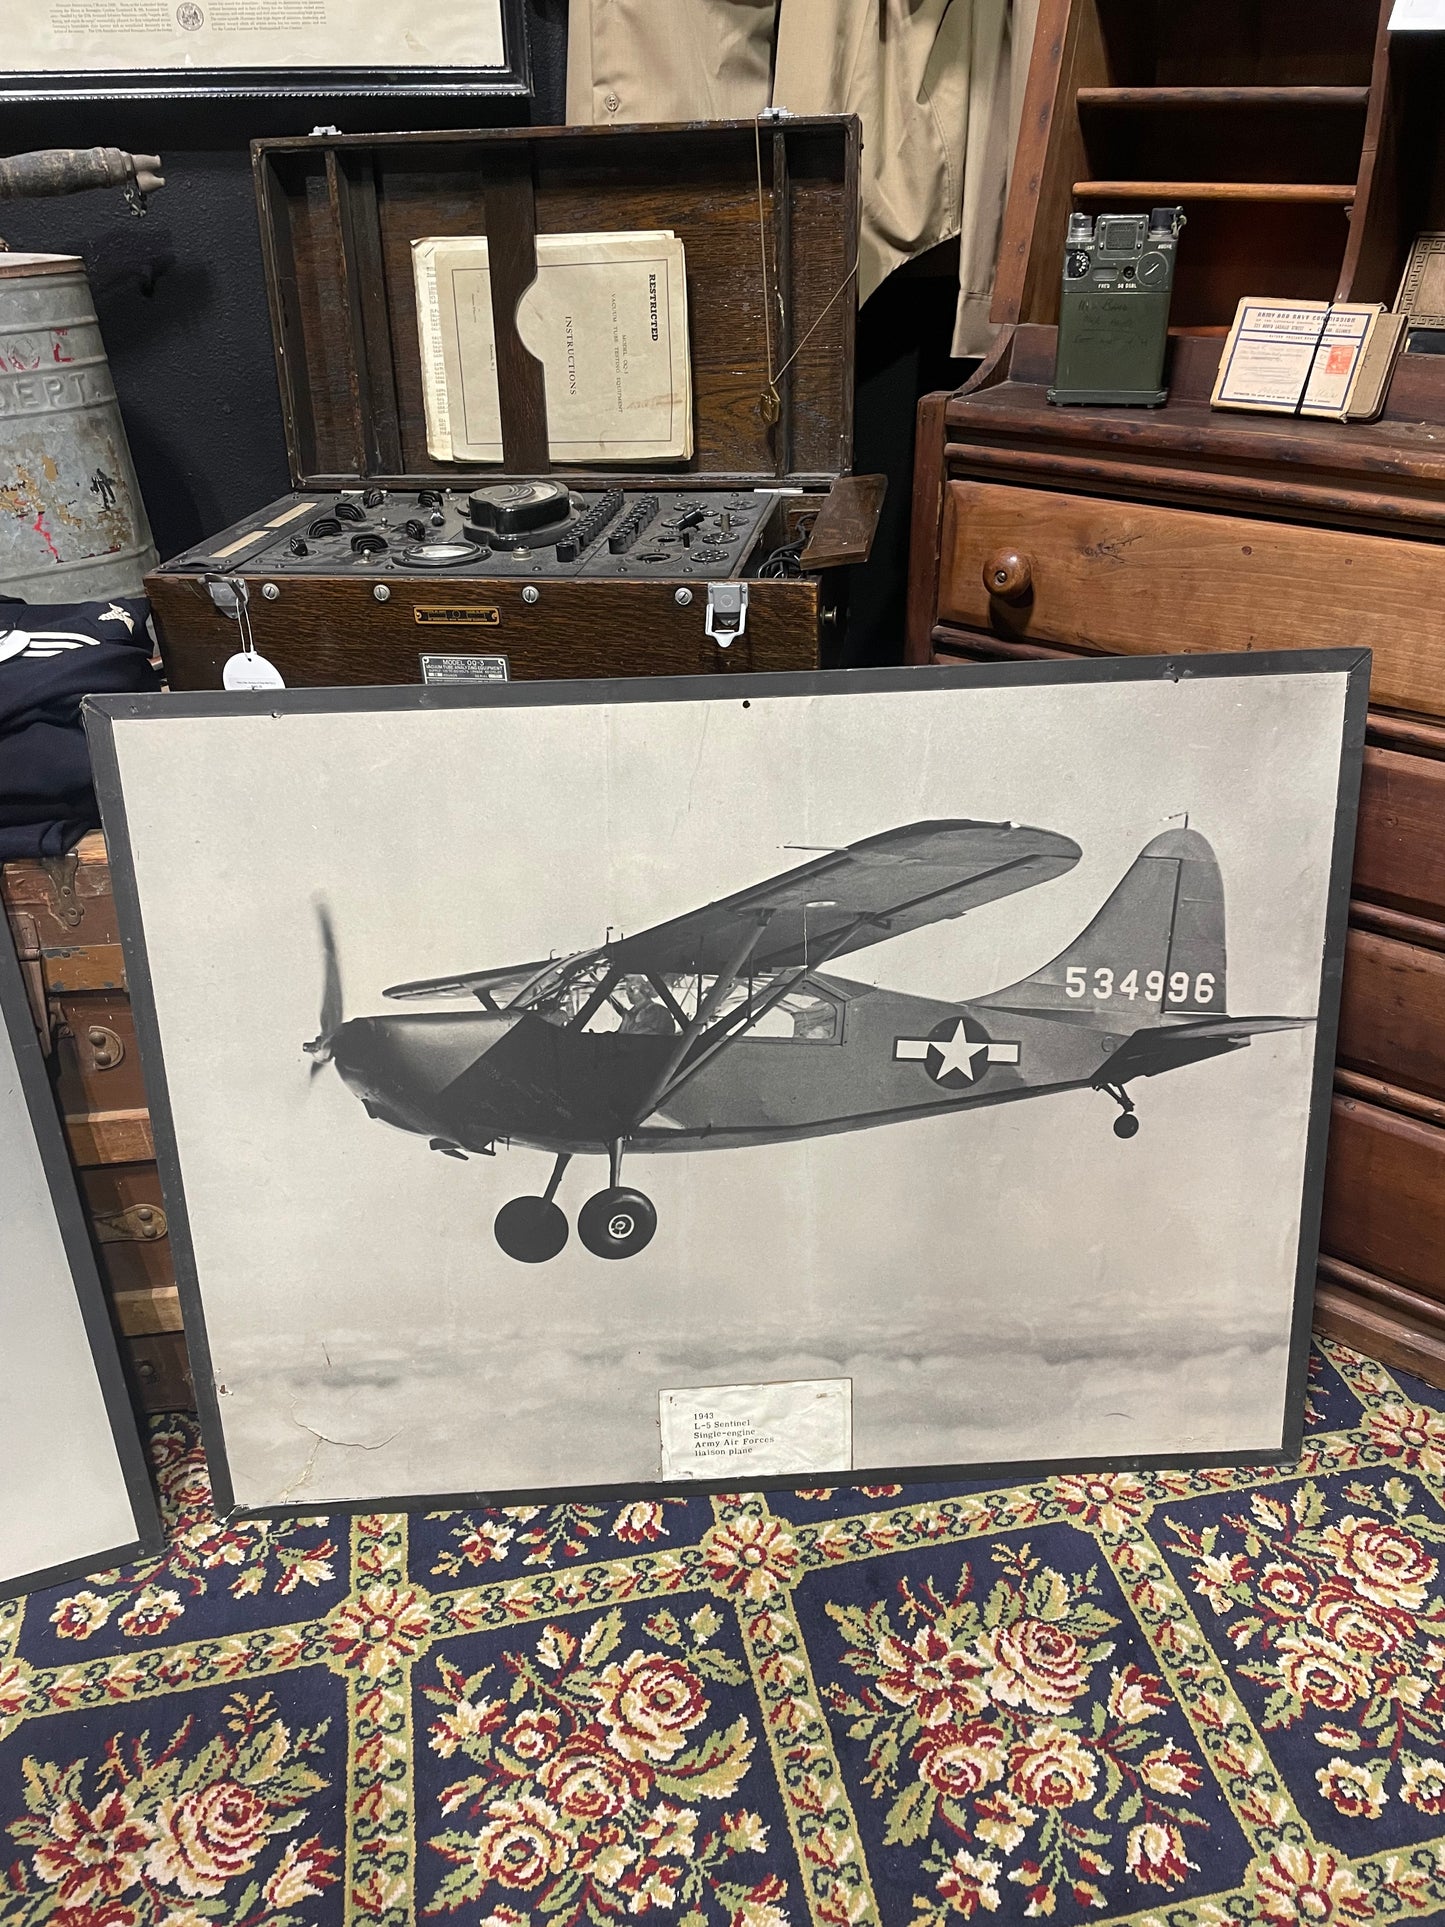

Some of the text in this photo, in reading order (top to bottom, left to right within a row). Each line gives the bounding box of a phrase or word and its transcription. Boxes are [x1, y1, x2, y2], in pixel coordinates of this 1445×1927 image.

[648, 274, 659, 342] RESTRICTED
[564, 315, 577, 396] INSTRUCTIONS
[0, 371, 102, 409] EPT.
[1065, 966, 1216, 1004] 534996
[694, 1412, 714, 1420] 1943
[694, 1419, 750, 1430] L-5 Sentinel
[693, 1428, 756, 1440] Single-engine
[695, 1440, 720, 1448] Army
[743, 1436, 775, 1445] Forces
[694, 1447, 753, 1457] liaison plane
